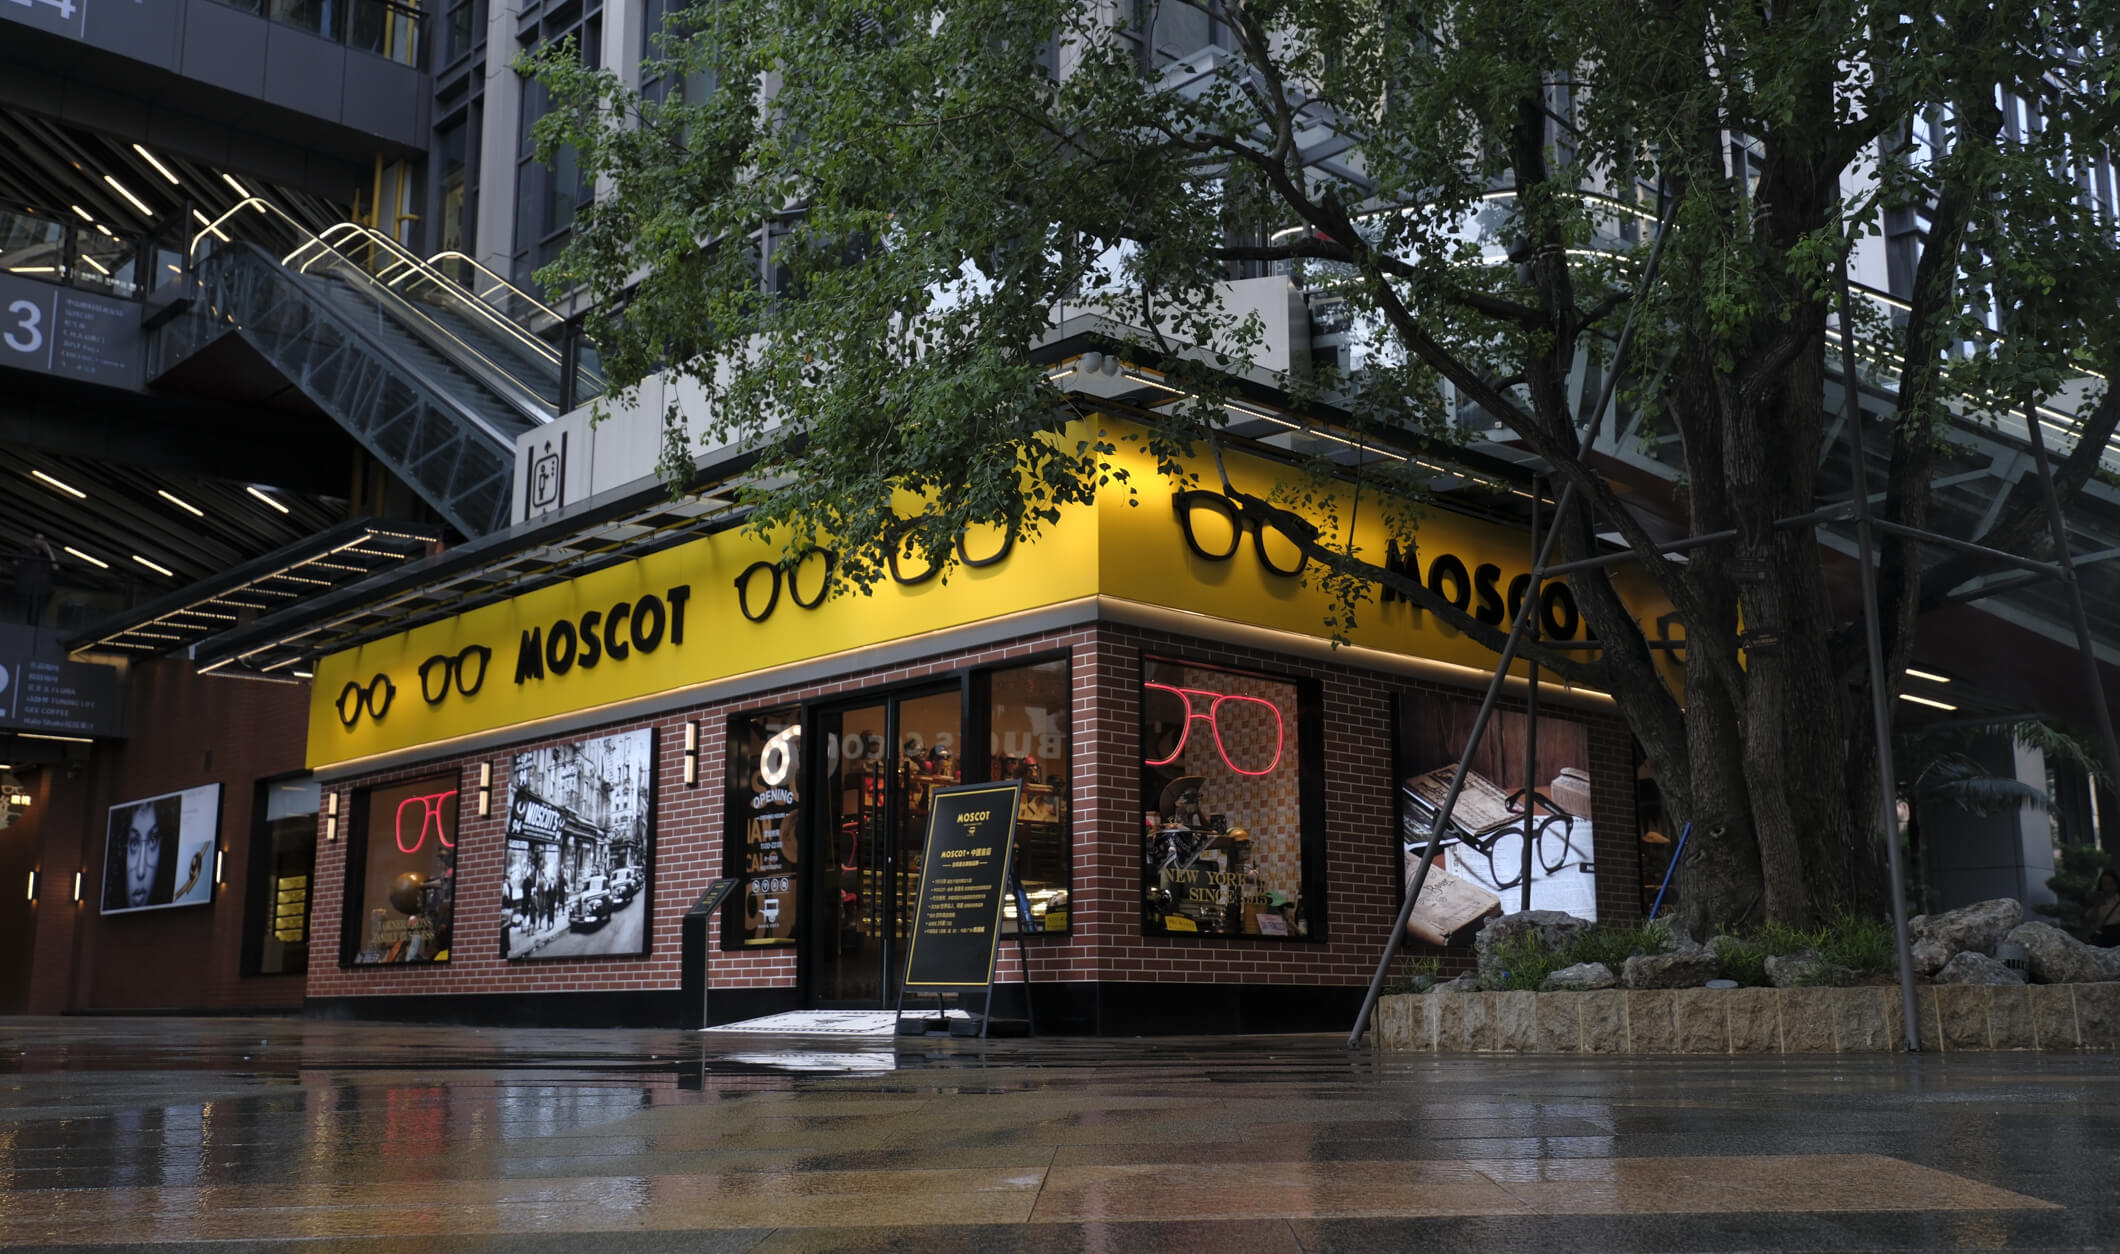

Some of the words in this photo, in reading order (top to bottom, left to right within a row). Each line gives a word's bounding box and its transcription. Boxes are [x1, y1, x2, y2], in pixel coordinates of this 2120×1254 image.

[3, 300, 43, 352] 3
[1380, 540, 1599, 643] MOSCO
[514, 585, 690, 685] MOSCOT
[753, 788, 794, 809] OPENING
[957, 811, 991, 823] MOSCOT
[941, 850, 966, 859] MOSCOT
[1165, 868, 1200, 884] NEW
[1206, 871, 1248, 886] YORK
[1189, 887, 1235, 904] SINCE
